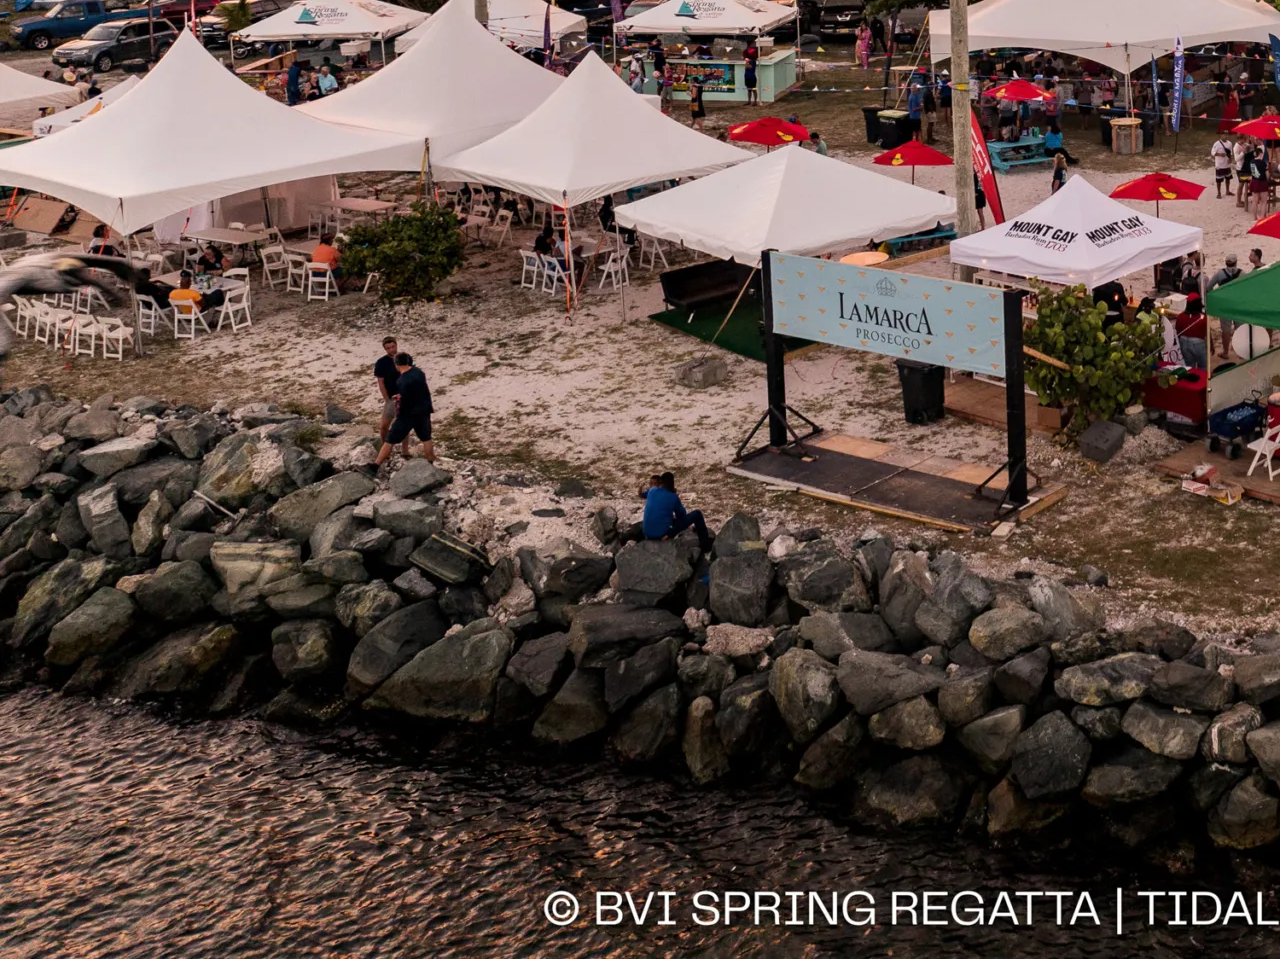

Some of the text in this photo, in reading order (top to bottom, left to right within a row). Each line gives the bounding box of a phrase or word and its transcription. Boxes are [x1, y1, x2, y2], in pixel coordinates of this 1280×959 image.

[1009, 221, 1079, 244] MOUNT GAY
[1085, 221, 1125, 244] MOUNT
[1121, 215, 1144, 230] GAY
[1131, 227, 1153, 239] 1703
[1005, 232, 1047, 244] Barbados Rum
[1095, 235, 1121, 248] Barbados
[1044, 241, 1068, 252] 1703
[856, 328, 921, 350] PROSECCO
